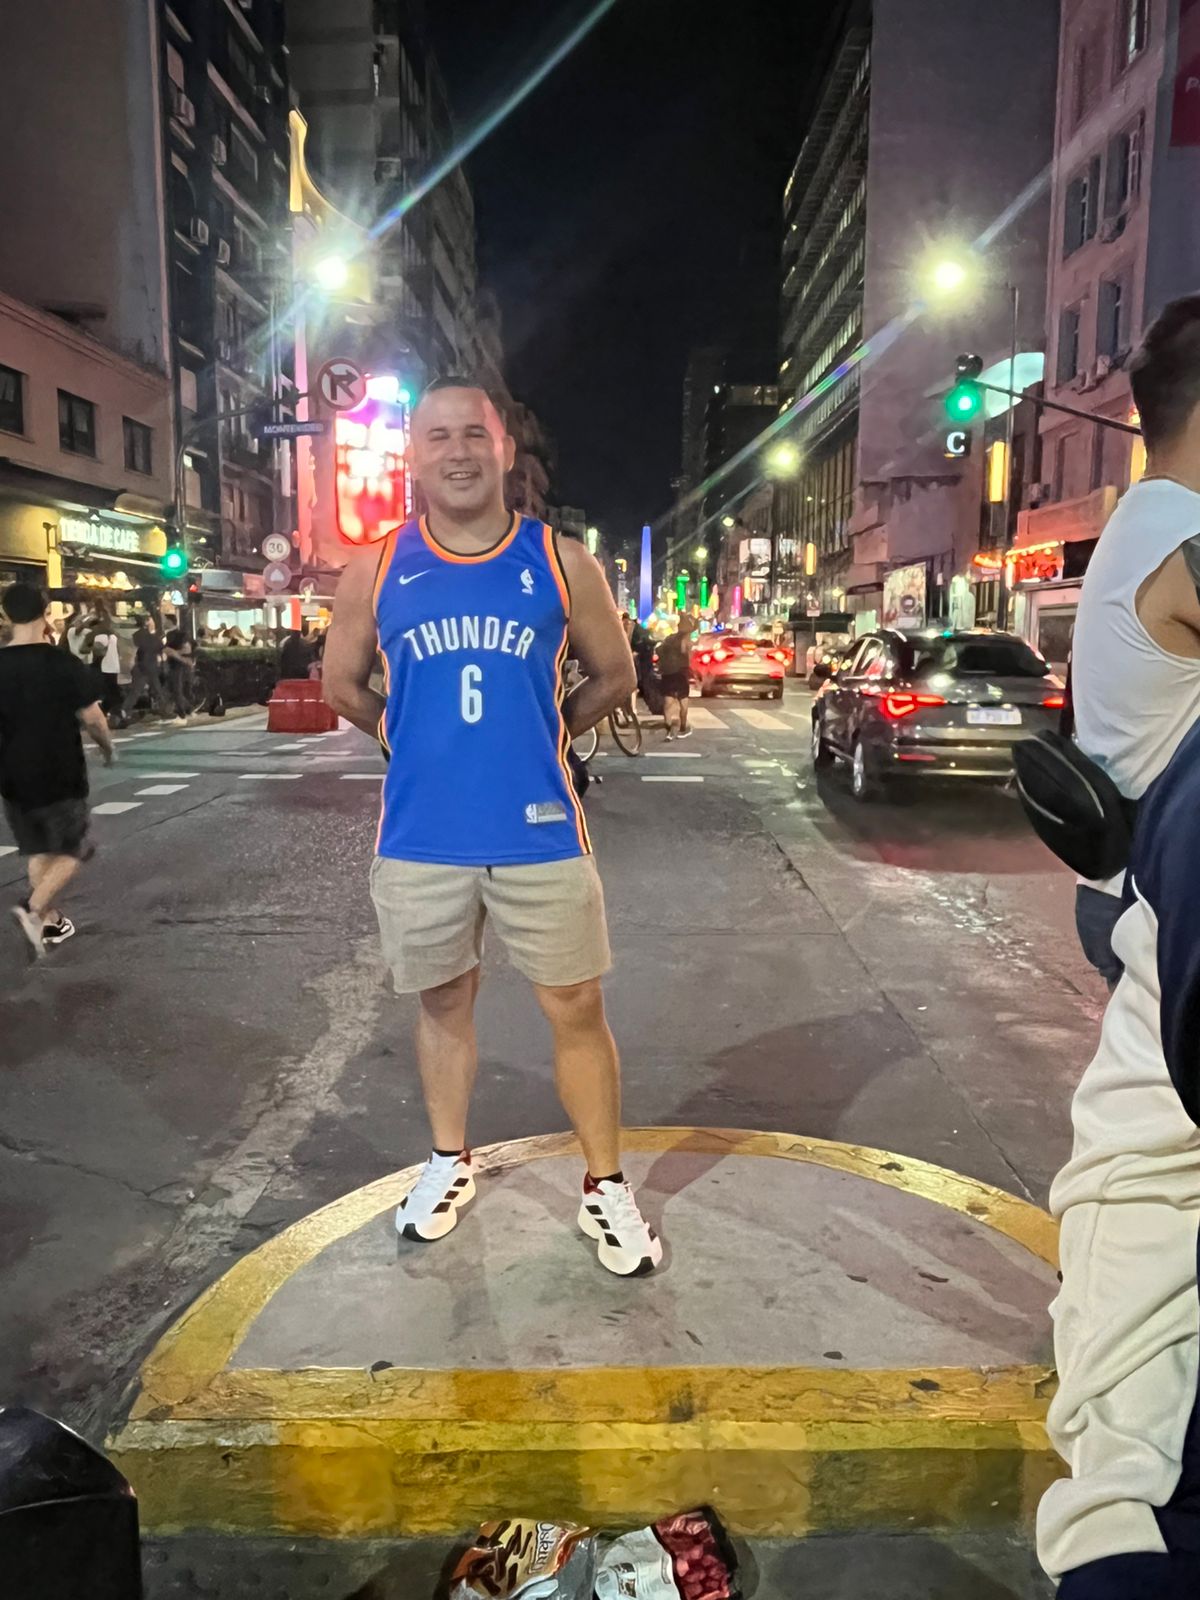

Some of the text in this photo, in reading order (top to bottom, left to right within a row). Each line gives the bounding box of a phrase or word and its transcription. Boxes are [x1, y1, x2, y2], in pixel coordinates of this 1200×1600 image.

[946, 431, 966, 454] C
[100, 524, 114, 548] DE
[268, 542, 284, 554] 30
[403, 615, 536, 661] THUNDER
[461, 663, 483, 724] 6
